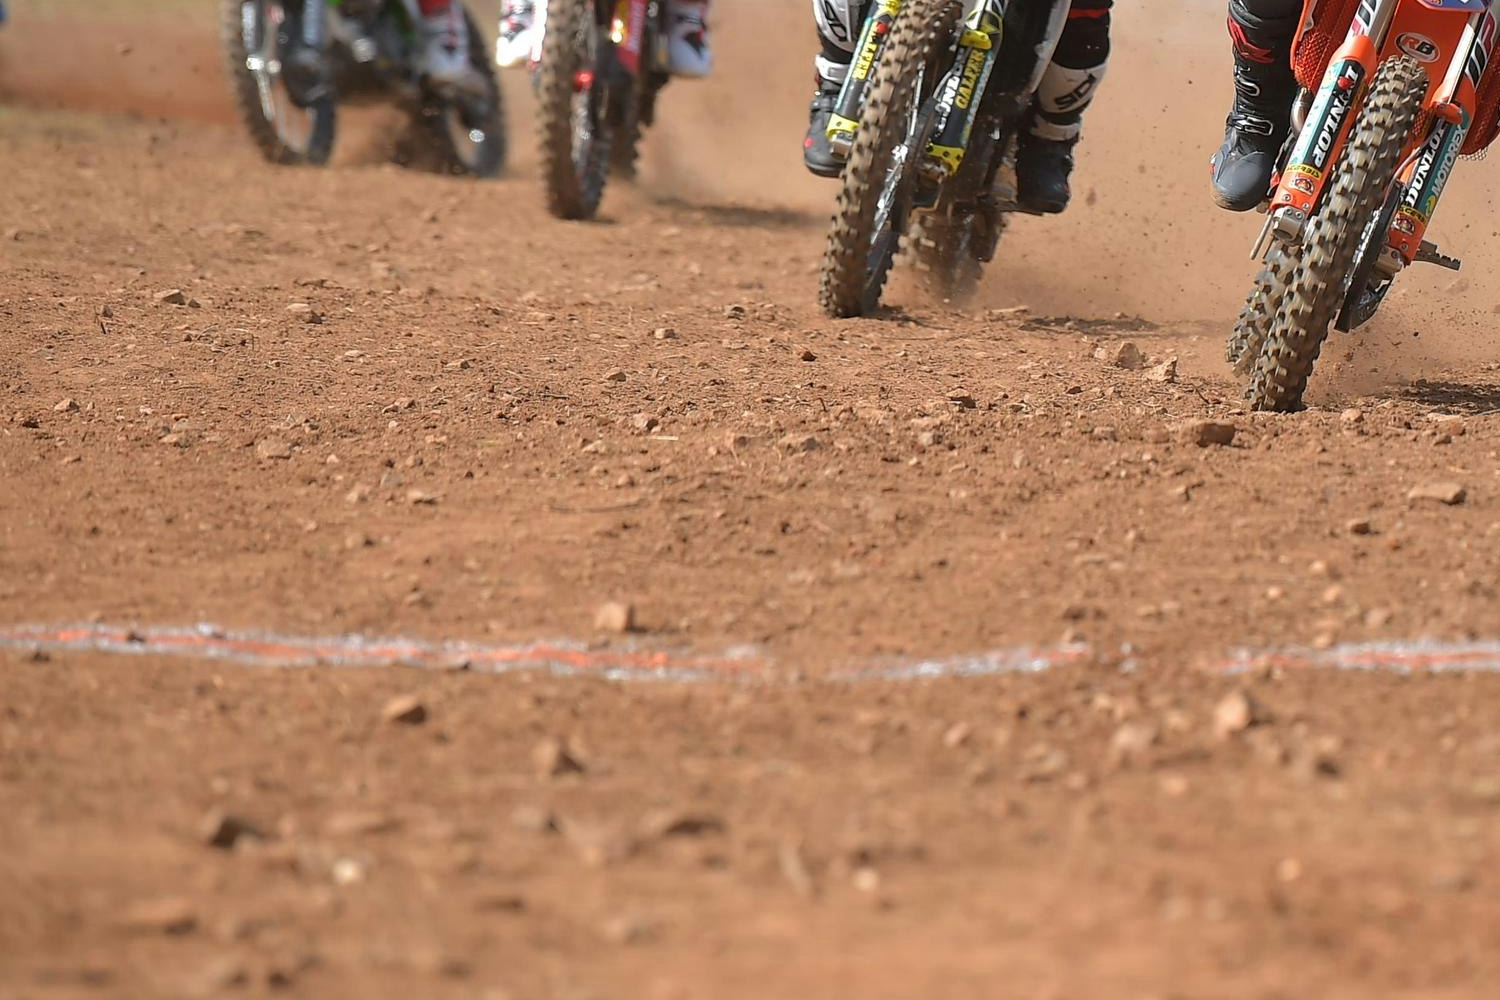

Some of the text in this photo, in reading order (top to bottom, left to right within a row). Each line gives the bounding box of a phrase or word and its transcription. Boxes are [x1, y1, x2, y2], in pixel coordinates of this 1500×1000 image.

[1403, 36, 1437, 55] RB
[1312, 65, 1359, 168] DNLOP
[1431, 123, 1467, 195] MOTOREX
